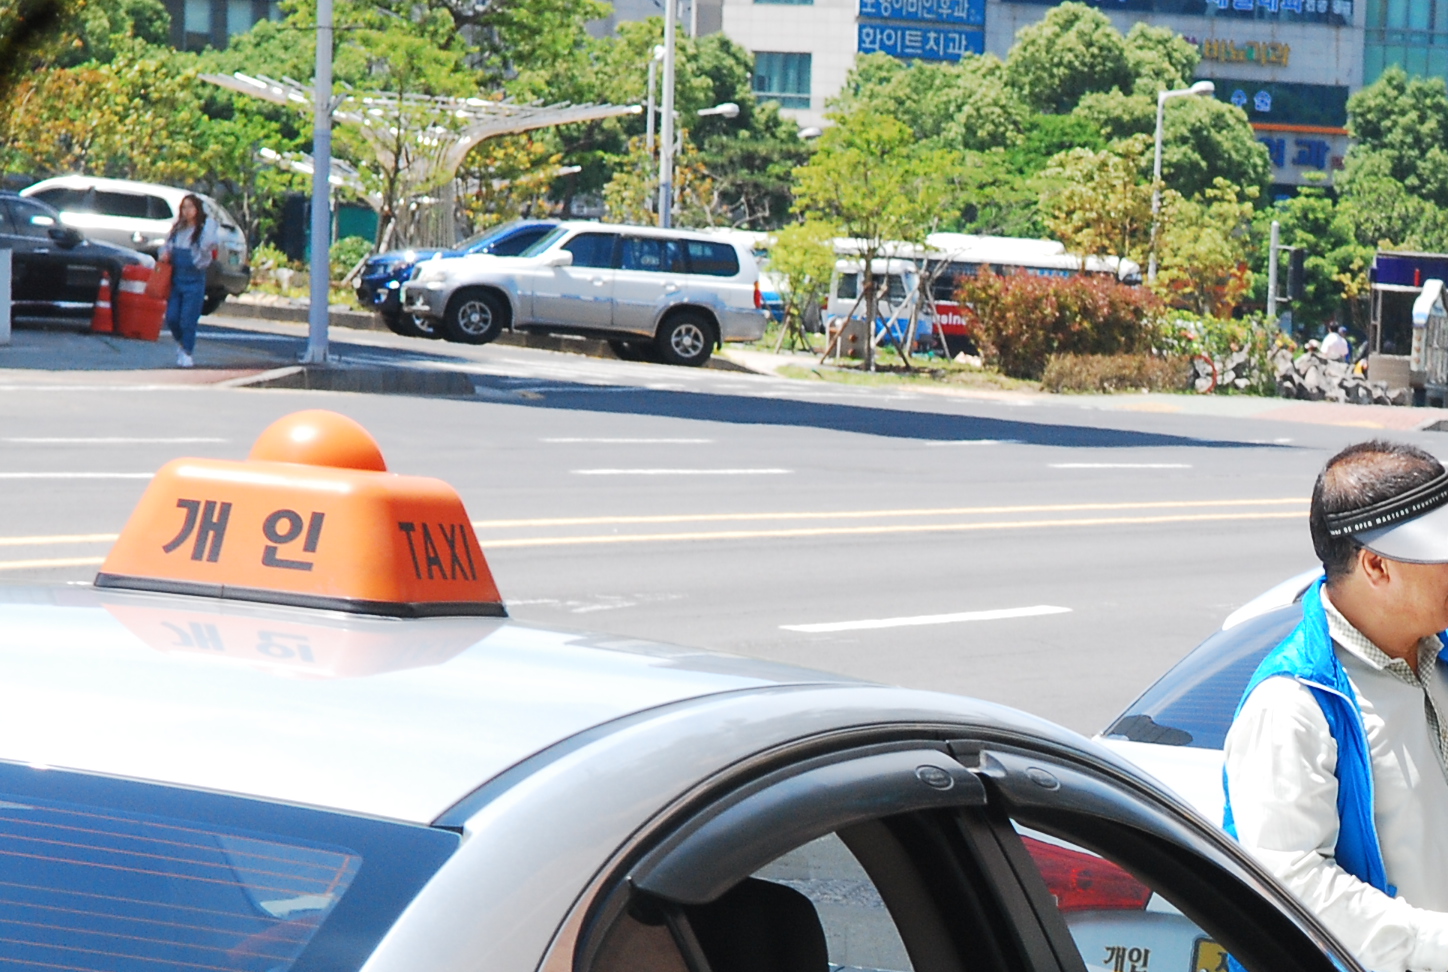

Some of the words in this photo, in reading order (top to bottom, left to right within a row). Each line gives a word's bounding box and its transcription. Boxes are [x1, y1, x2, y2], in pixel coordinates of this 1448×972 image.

[861, 26, 967, 56] 화이트치과
[161, 498, 326, 572] 개인
[398, 521, 478, 582] TAXI
